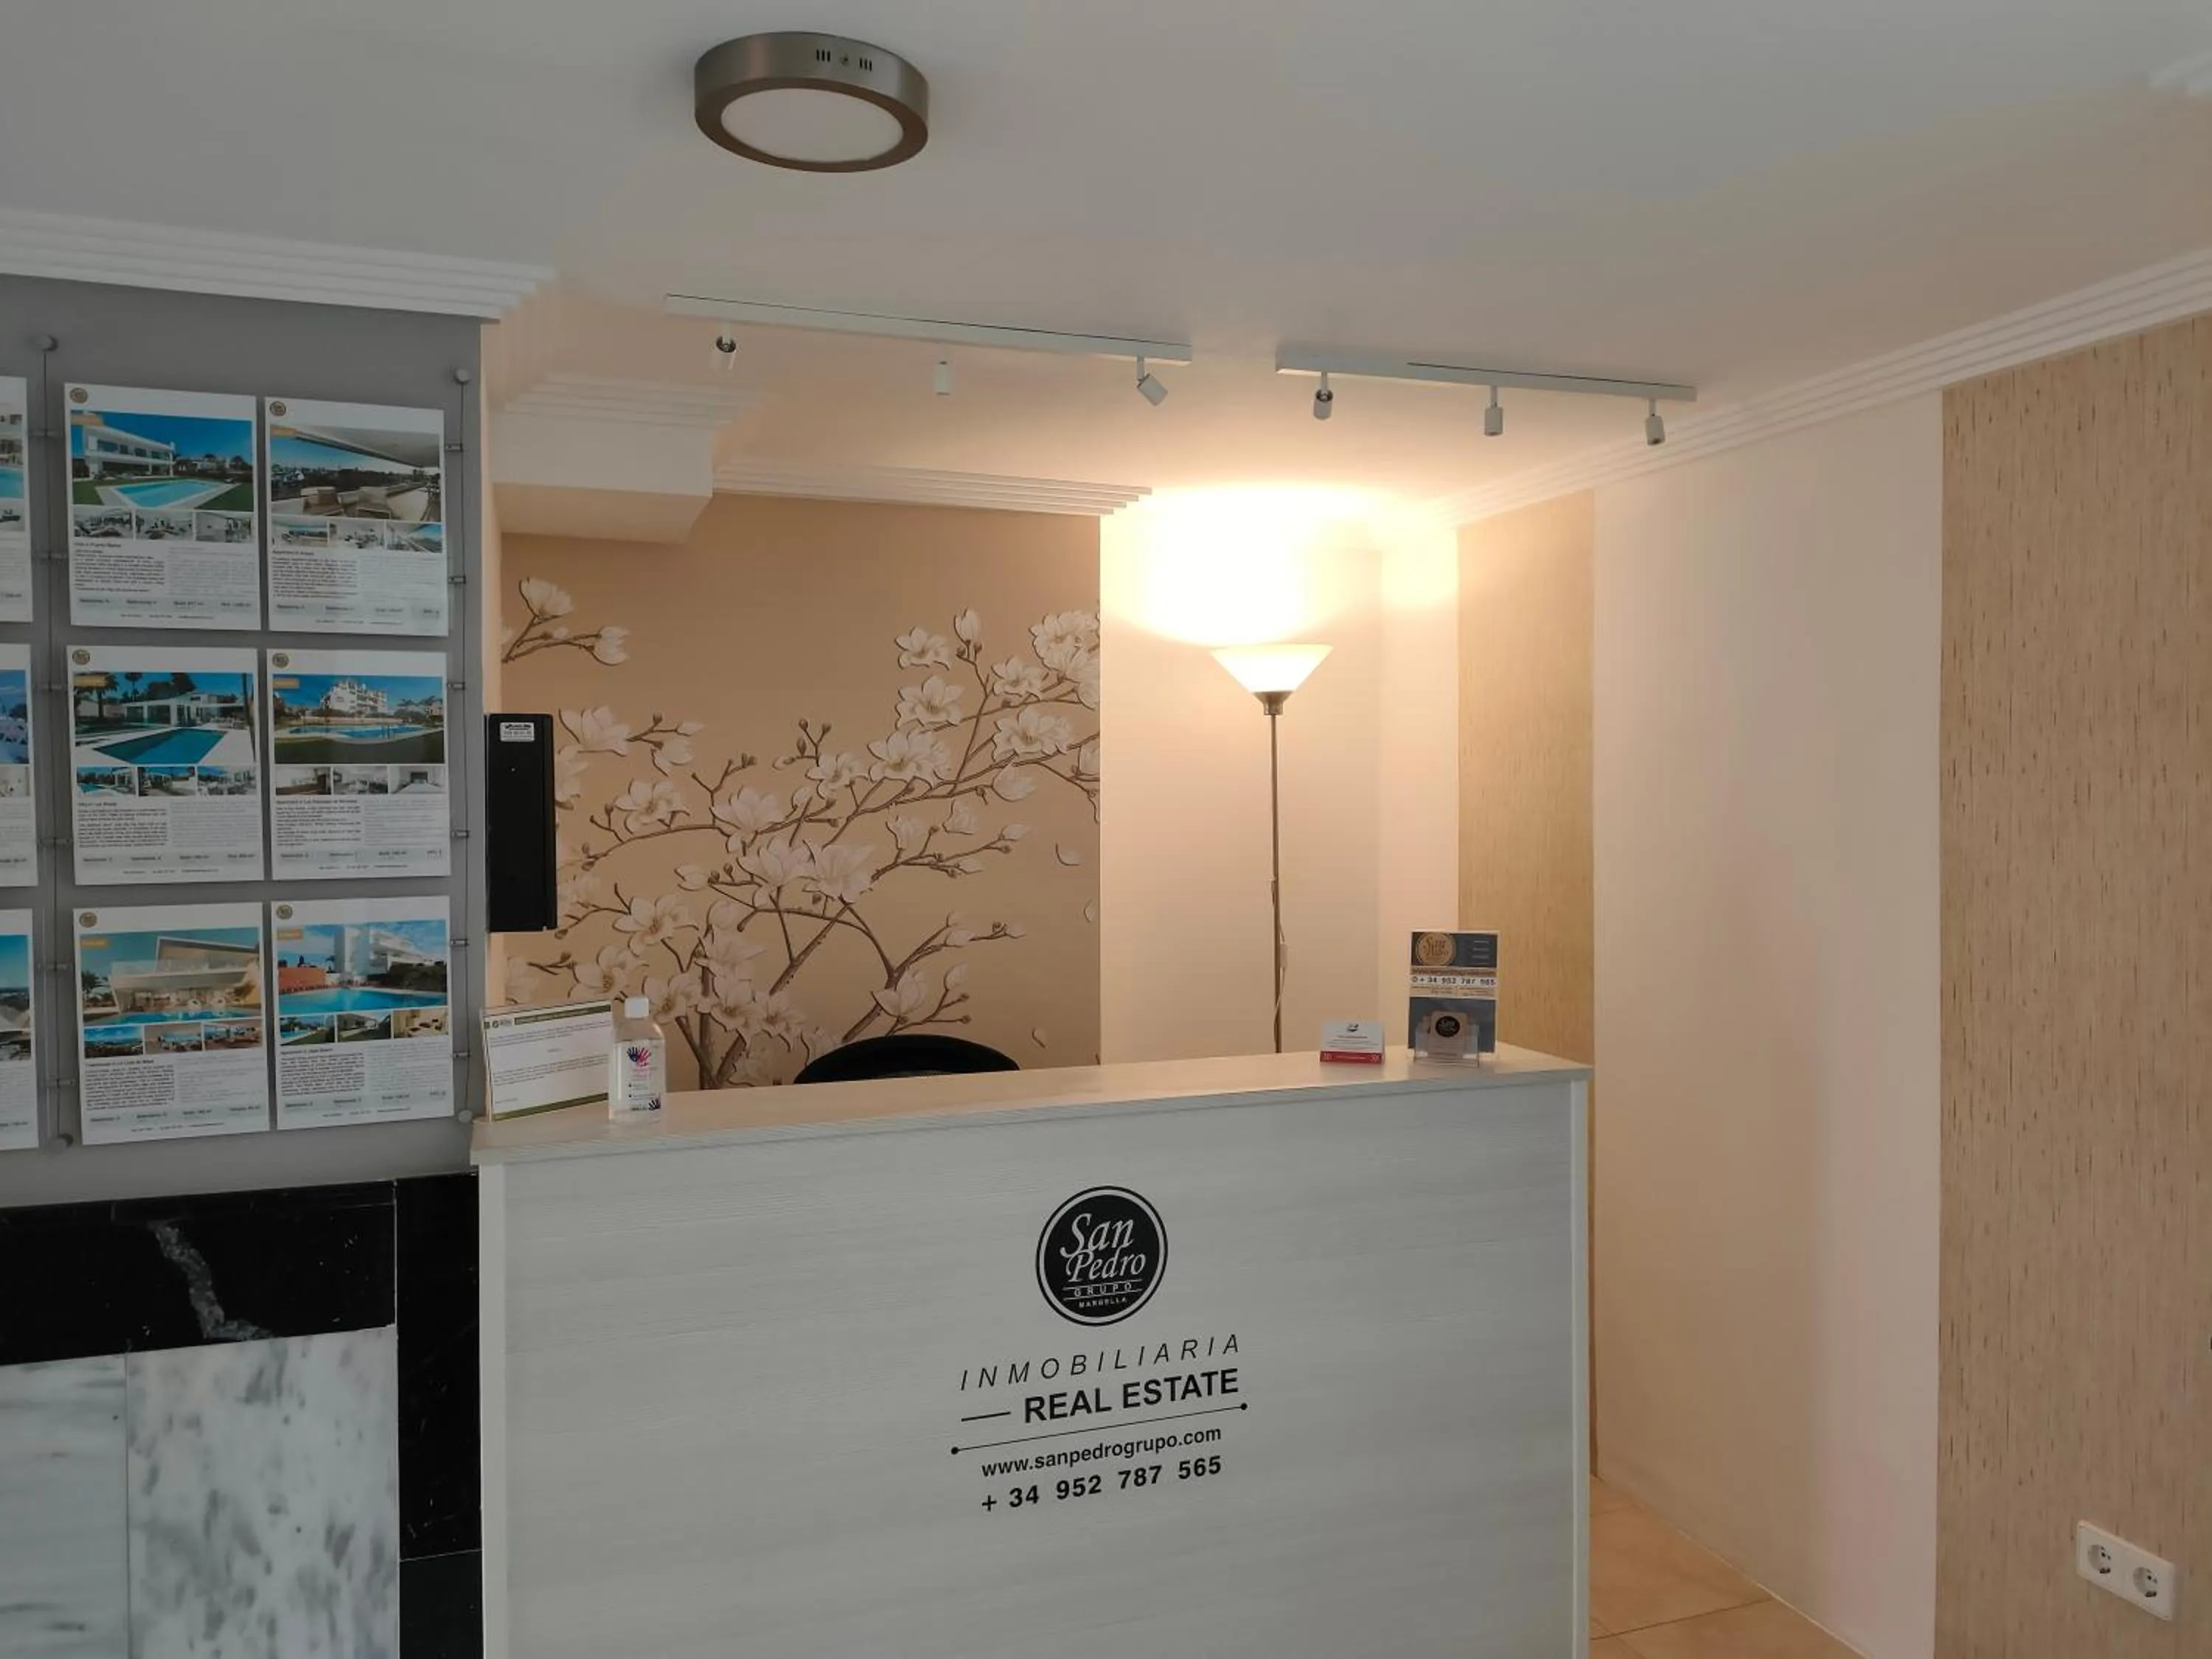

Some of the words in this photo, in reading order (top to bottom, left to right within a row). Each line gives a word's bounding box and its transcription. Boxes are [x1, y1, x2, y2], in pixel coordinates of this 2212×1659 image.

[1060, 1213, 1135, 1258] San
[1066, 1246, 1147, 1282] Pedro
[1074, 1282, 1132, 1297] GRUPO
[961, 1334, 1239, 1391] INMOBILIARIA
[1024, 1387, 1113, 1423] REAL
[1122, 1368, 1239, 1409] ESTATE
[981, 1427, 1222, 1477] www.sanpedrogrupo.com
[1009, 1485, 1040, 1508] 34
[1056, 1475, 1102, 1500] 952
[1118, 1465, 1163, 1489] 787
[1178, 1455, 1222, 1480] 565
